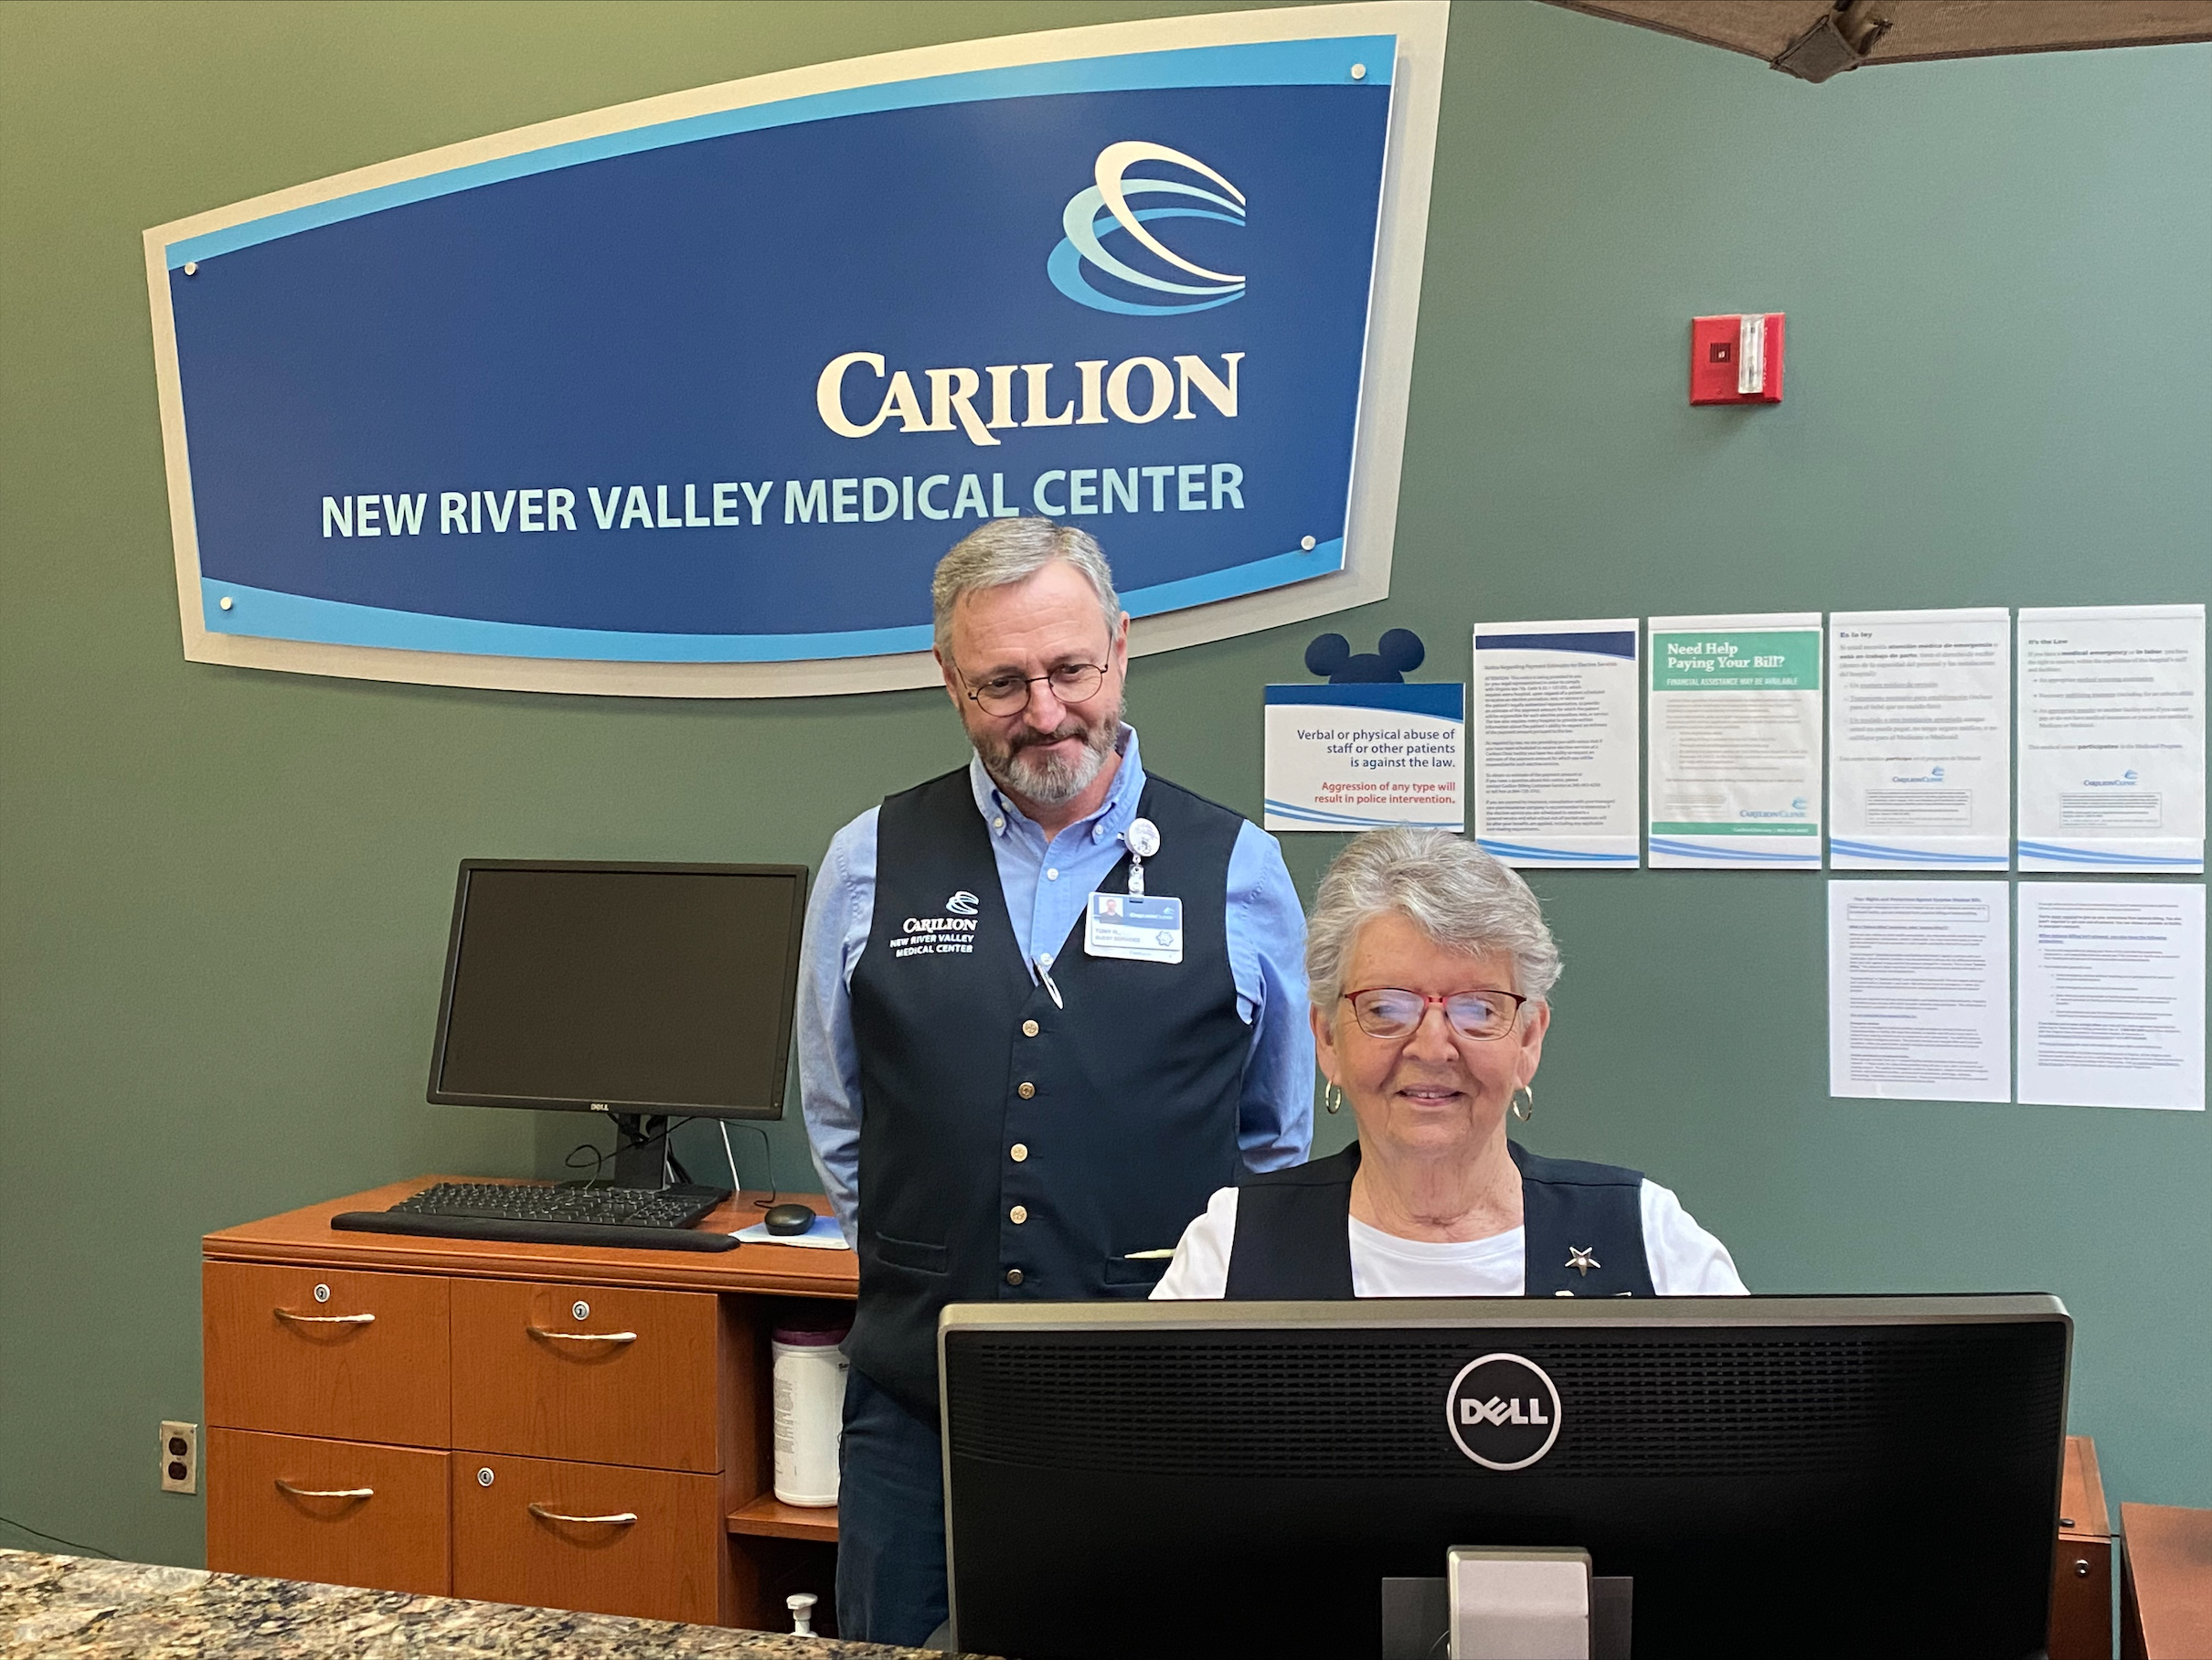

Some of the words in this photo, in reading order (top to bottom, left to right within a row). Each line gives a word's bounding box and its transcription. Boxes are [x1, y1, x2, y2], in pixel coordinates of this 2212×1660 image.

[816, 352, 1246, 446] CARILION
[322, 493, 428, 537] NEW
[440, 488, 578, 535] RIVER
[587, 481, 774, 530] VALLEY
[784, 473, 1020, 524] MEDICAL
[1032, 463, 1246, 517] CENTER
[1666, 643, 1703, 654] Need
[1705, 642, 1739, 657] Help
[1667, 656, 1716, 672] Paying
[1717, 656, 1751, 668] Your
[1752, 655, 1786, 668] Bill?
[1700, 677, 1739, 686] ASSISTANCE
[1764, 676, 1799, 685] AVAILABLE
[1297, 729, 1335, 740] Verbal
[1337, 731, 1351, 740] or
[1353, 729, 1400, 742] physical
[1403, 729, 1440, 740] abuse
[1442, 729, 1456, 740] of
[1326, 743, 1353, 754] staff
[1356, 745, 1368, 754] or
[1371, 743, 1404, 754] other
[1407, 743, 1456, 756] patients
[1350, 757, 1359, 768] is
[1362, 757, 1406, 770] against
[1409, 757, 1429, 768] the
[1431, 757, 1456, 768] law.
[1321, 782, 1377, 793] Aggression
[1379, 782, 1390, 792] of
[1392, 783, 1409, 793] any
[1412, 783, 1435, 793] type
[1438, 782, 1456, 792] will
[1314, 794, 1342, 803] result
[1345, 794, 1355, 803] in
[1356, 794, 1387, 804] police
[1389, 794, 1456, 804] intervention.
[903, 918, 978, 933] CARILION
[889, 938, 909, 948] NEW
[910, 934, 937, 945] RIVER
[938, 933, 974, 943] VALLEY
[896, 945, 934, 958] MEDICAL
[936, 944, 973, 953] CENTER
[1460, 1396, 1548, 1426] DELL
